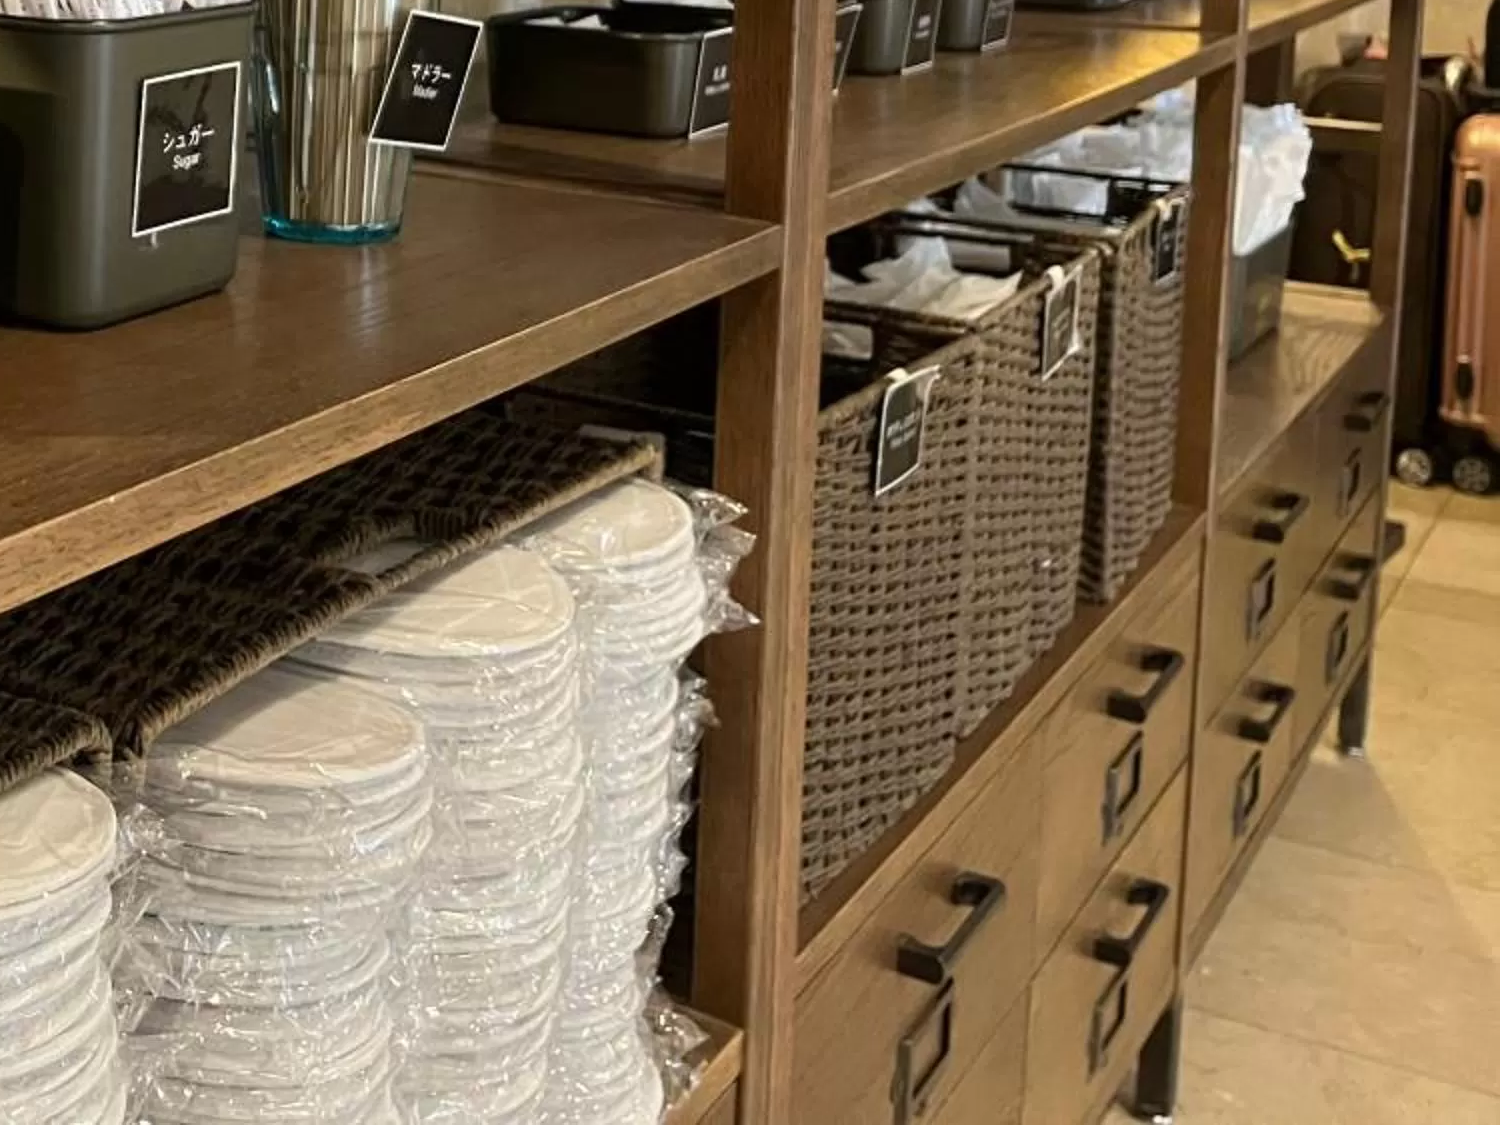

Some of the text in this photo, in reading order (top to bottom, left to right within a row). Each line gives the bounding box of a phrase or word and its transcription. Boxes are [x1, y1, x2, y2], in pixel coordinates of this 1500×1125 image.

[411, 63, 451, 83] マドラー
[163, 123, 215, 153] シュガー
